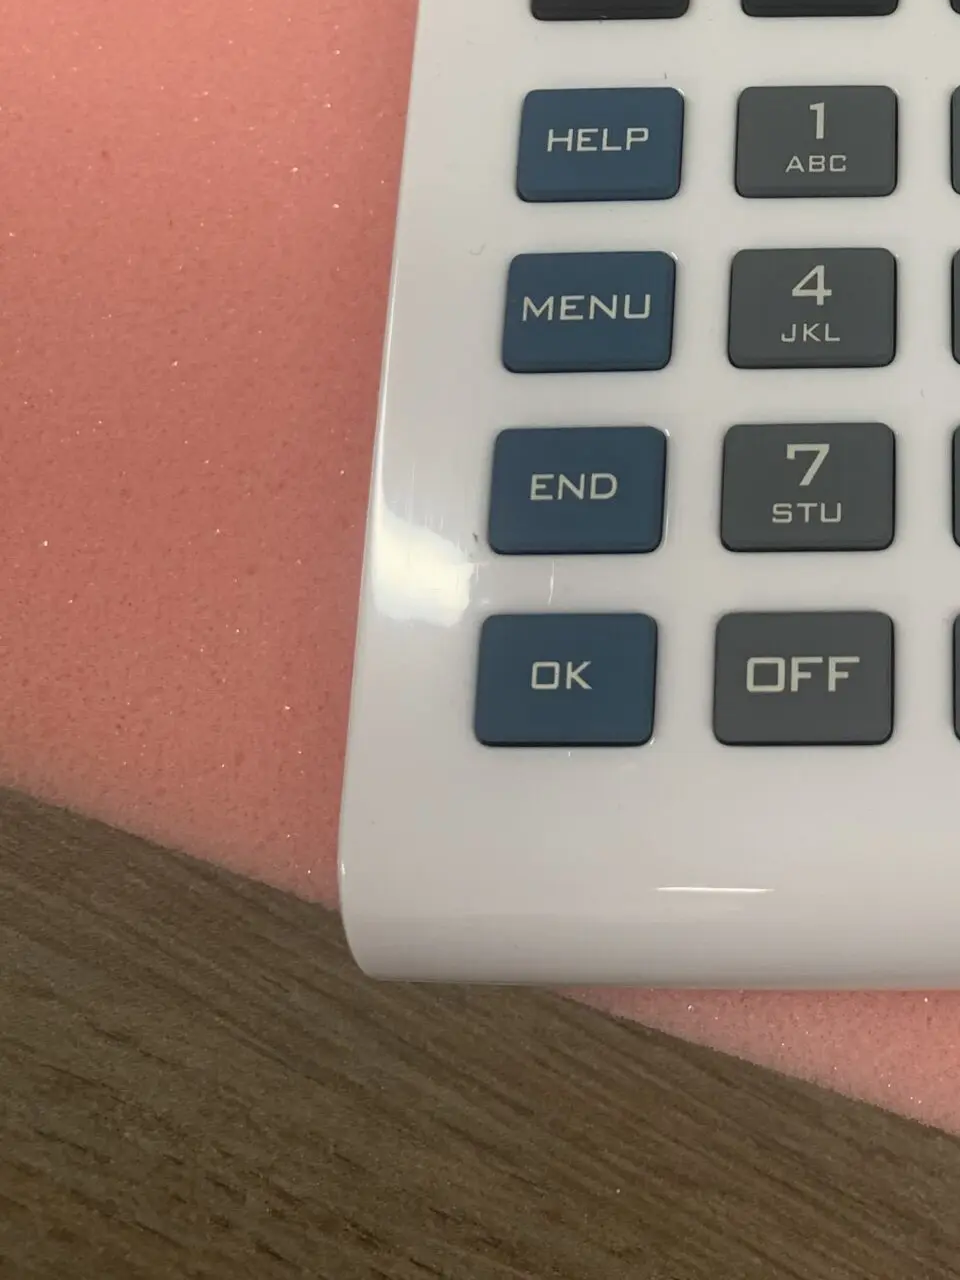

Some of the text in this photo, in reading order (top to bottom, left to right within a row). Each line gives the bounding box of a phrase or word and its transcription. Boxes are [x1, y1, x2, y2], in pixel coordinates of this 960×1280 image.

[809, 102, 825, 140] 1
[547, 127, 649, 152] HELP
[785, 154, 847, 173] ABC
[791, 264, 833, 306] 4
[522, 294, 651, 321] MENU
[781, 323, 841, 343] JKL
[786, 443, 830, 486] 7
[530, 473, 618, 501] END
[771, 502, 842, 524] STU
[531, 661, 593, 690] OK
[746, 656, 860, 693] OFF
